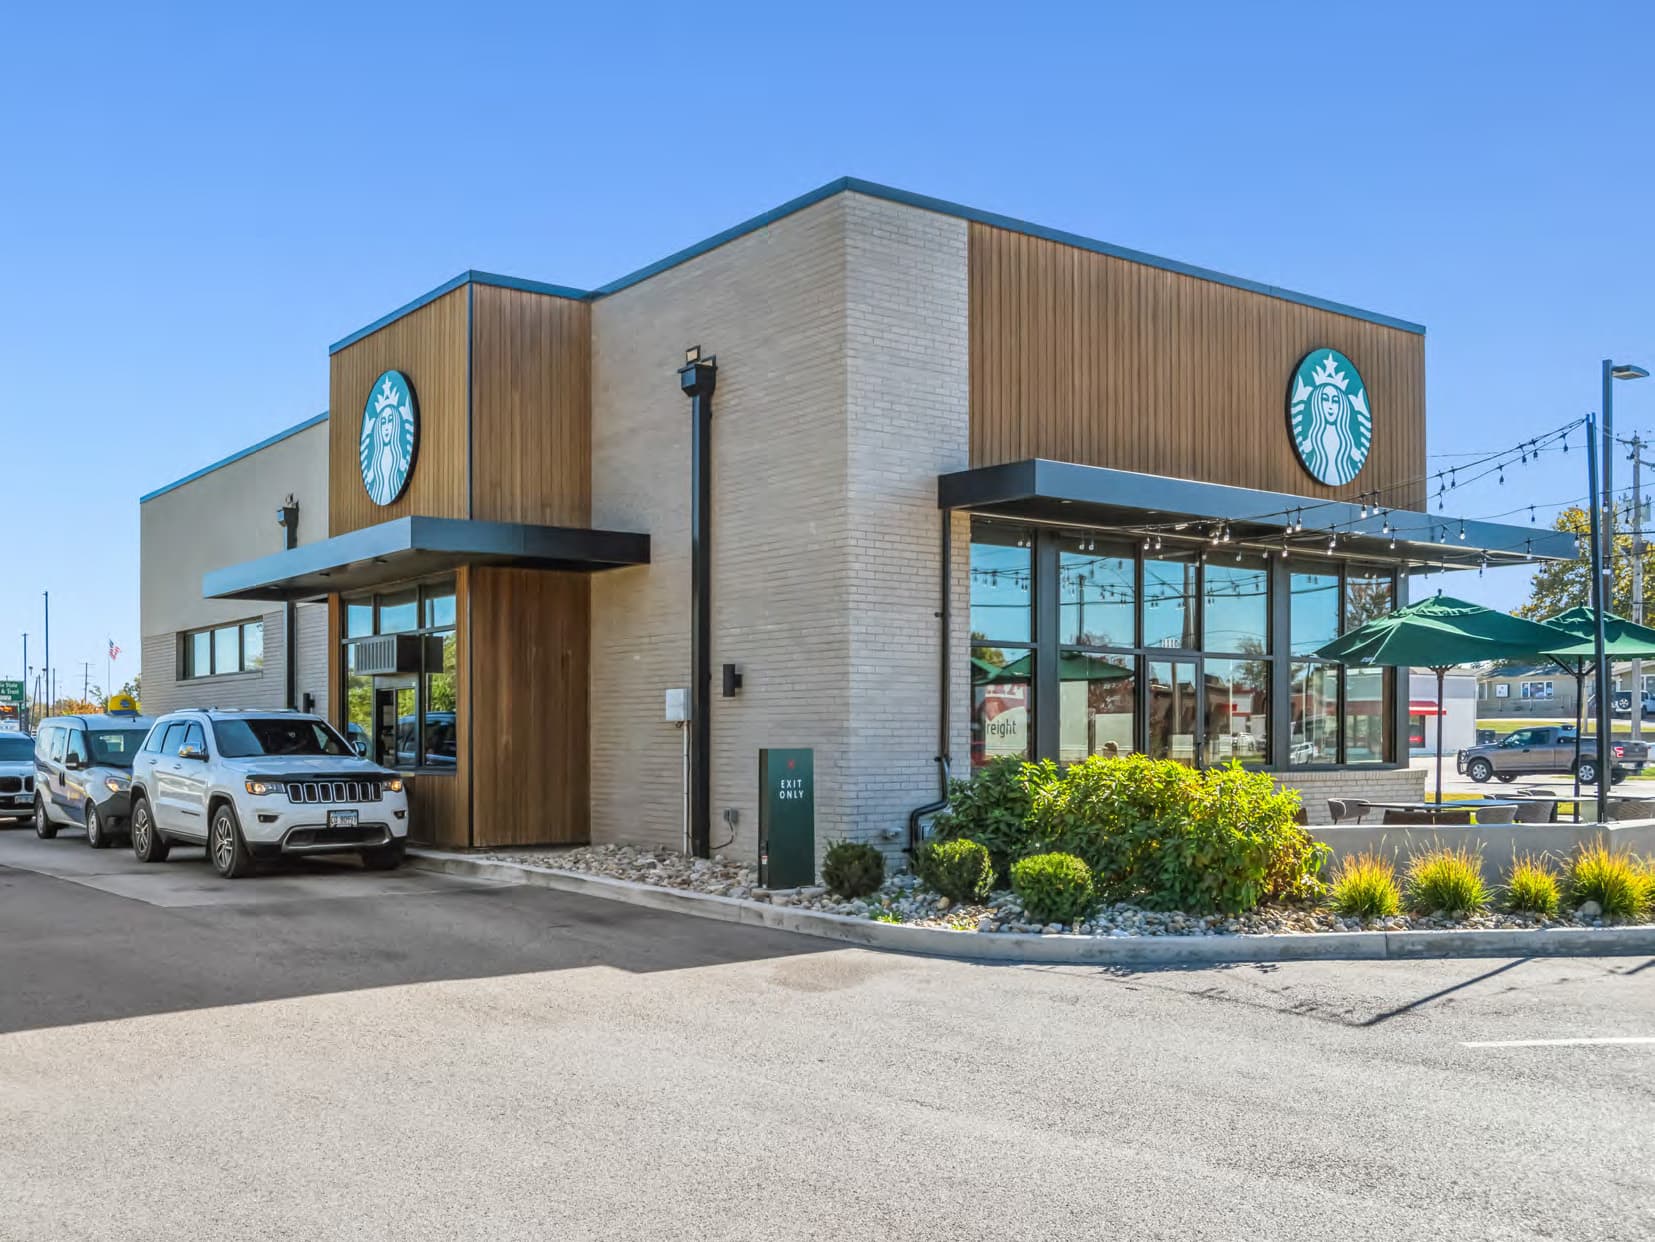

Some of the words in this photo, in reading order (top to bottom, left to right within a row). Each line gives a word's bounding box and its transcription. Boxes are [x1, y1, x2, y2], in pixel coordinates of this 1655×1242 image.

[985, 718, 1017, 738] reight
[780, 779, 802, 789] EXIT
[779, 790, 805, 800] ONLY
